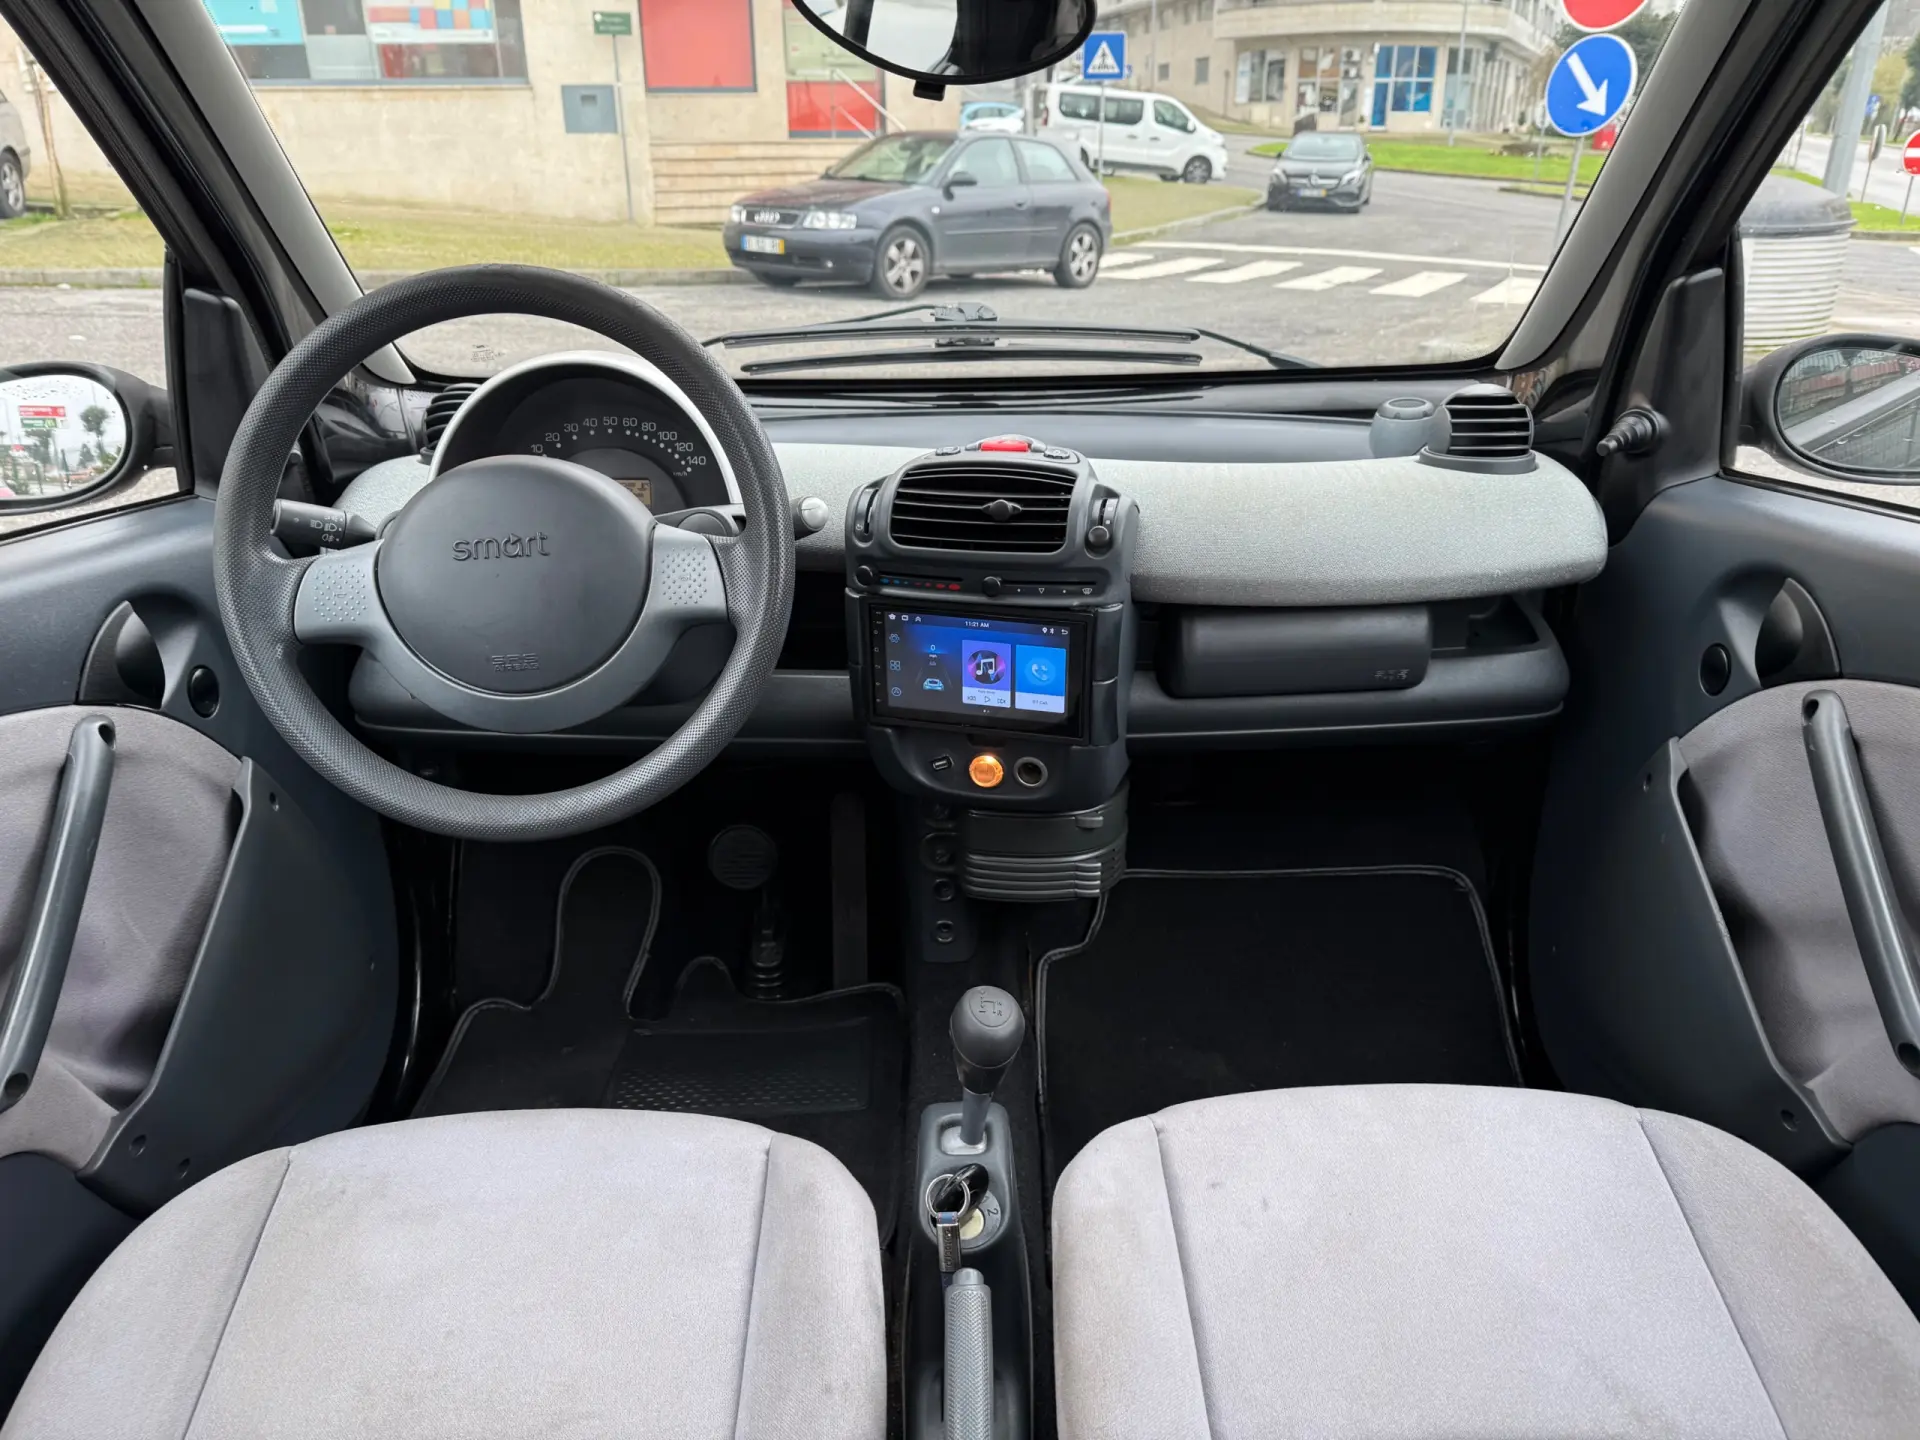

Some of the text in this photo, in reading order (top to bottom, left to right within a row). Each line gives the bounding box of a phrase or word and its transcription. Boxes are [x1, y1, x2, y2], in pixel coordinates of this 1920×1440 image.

[583, 417, 598, 427] 40
[603, 416, 618, 426] 50
[622, 417, 638, 427] 60
[564, 423, 579, 433] 30
[641, 422, 657, 432] 80
[545, 432, 560, 442] 20
[658, 431, 678, 441] 100
[531, 444, 543, 453] 10
[674, 442, 694, 452] 120
[686, 456, 706, 466] 140
[452, 532, 551, 562] smart
